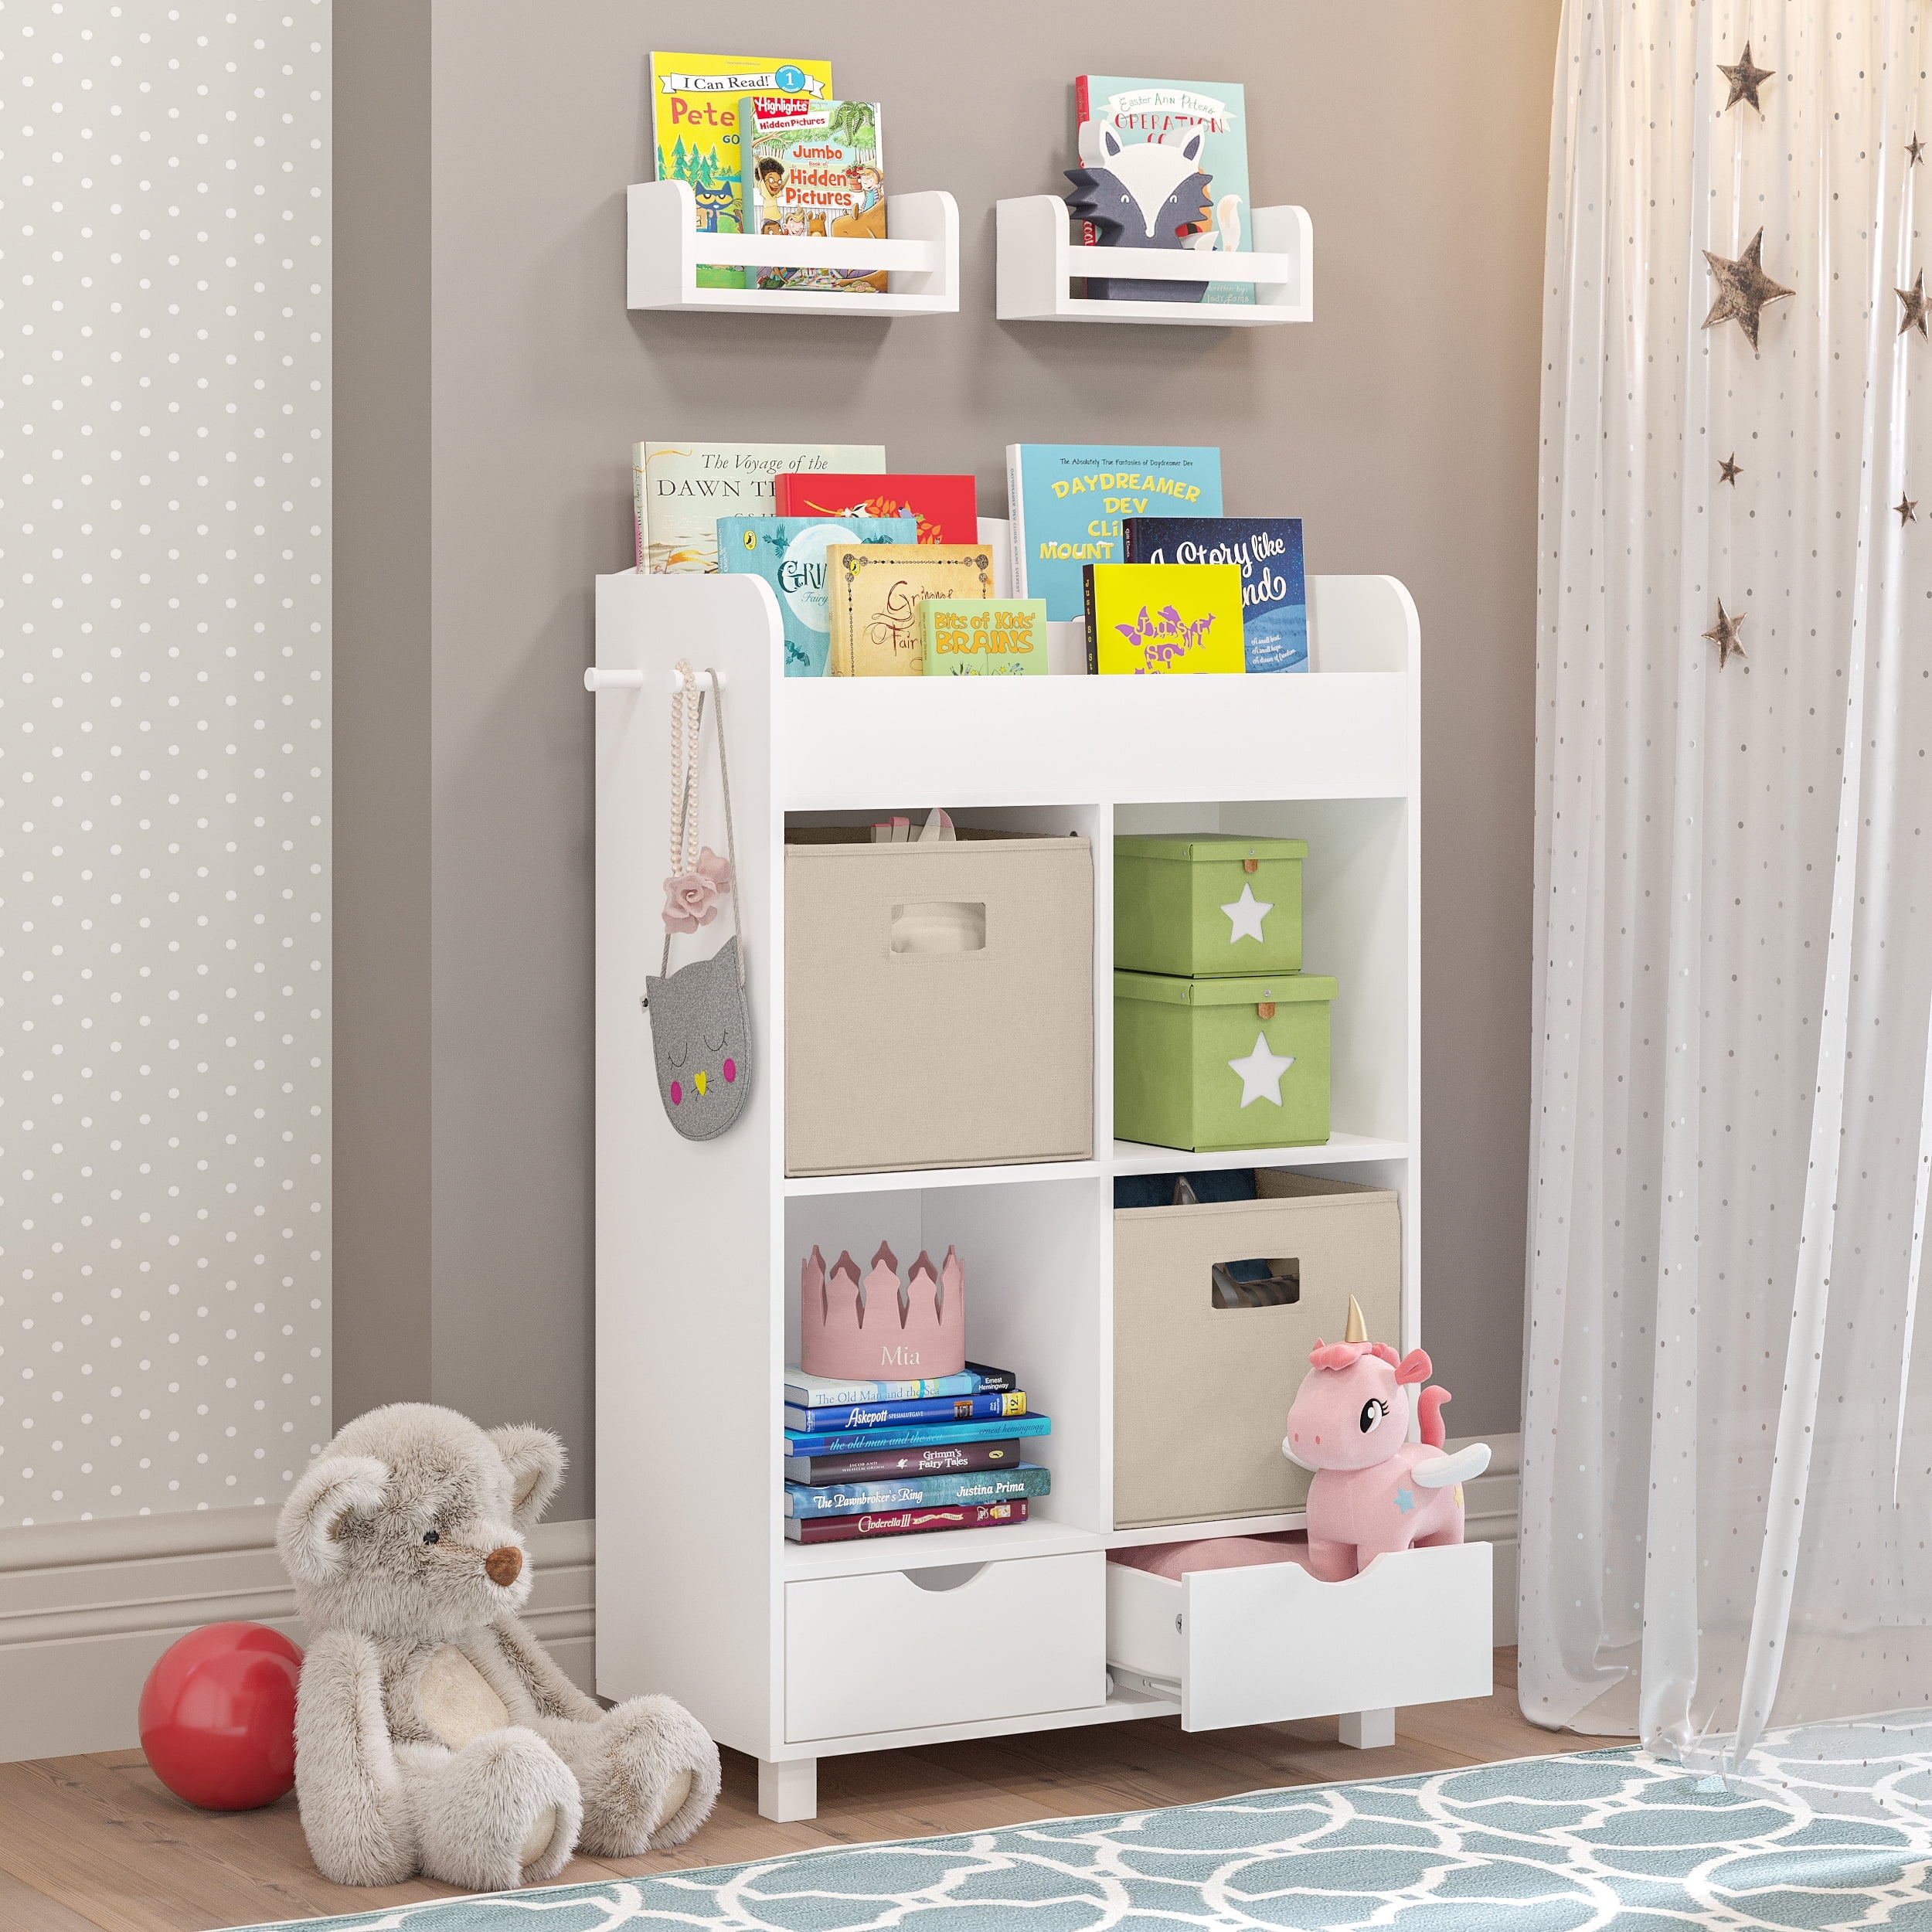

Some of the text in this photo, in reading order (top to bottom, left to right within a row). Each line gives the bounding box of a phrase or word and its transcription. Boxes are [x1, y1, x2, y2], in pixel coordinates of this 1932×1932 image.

[685, 77, 689, 88] I
[695, 78, 723, 90] Can
[786, 73, 794, 86] 1
[671, 97, 736, 126] Pete
[754, 98, 808, 115] Highlights
[1119, 96, 1151, 112] Easter
[760, 117, 825, 130] Hidden Pictures
[793, 145, 842, 159] Jumbo
[790, 169, 847, 186] Hidden
[785, 187, 852, 206] Pictures
[702, 454, 828, 474] The Voyage of the
[1072, 458, 1100, 468] Absolutely
[1150, 459, 1181, 468] Daydreamer
[657, 479, 740, 497] DAWN
[1051, 473, 1201, 502] DAYDREAMER
[1104, 498, 1148, 514] DEV
[1088, 520, 1123, 537] CLi
[1039, 541, 1115, 560] MOUNT
[1251, 532, 1286, 562] like
[777, 560, 828, 593] GRI
[801, 592, 828, 607] Fairy
[934, 612, 1036, 629] Bits of Kids'
[872, 621, 923, 656] Fair
[935, 631, 1034, 654] BRAINS
[881, 1346, 921, 1366] Mia
[816, 1386, 940, 1405] The Old Man and the Sea
[845, 1408, 887, 1428] Askepott
[978, 1423, 1043, 1434] ernest hemingway
[830, 1438, 845, 1451] the
[847, 1436, 865, 1449] old
[889, 1433, 910, 1445] and
[910, 1431, 924, 1443] the
[923, 1448, 962, 1461] Grimm's
[918, 1458, 968, 1470] Fairy Tales
[957, 1481, 1025, 1497] Justina Prima
[813, 1488, 923, 1509] The Pawnbroker's Ring
[858, 1513, 912, 1532] Cinderella III
